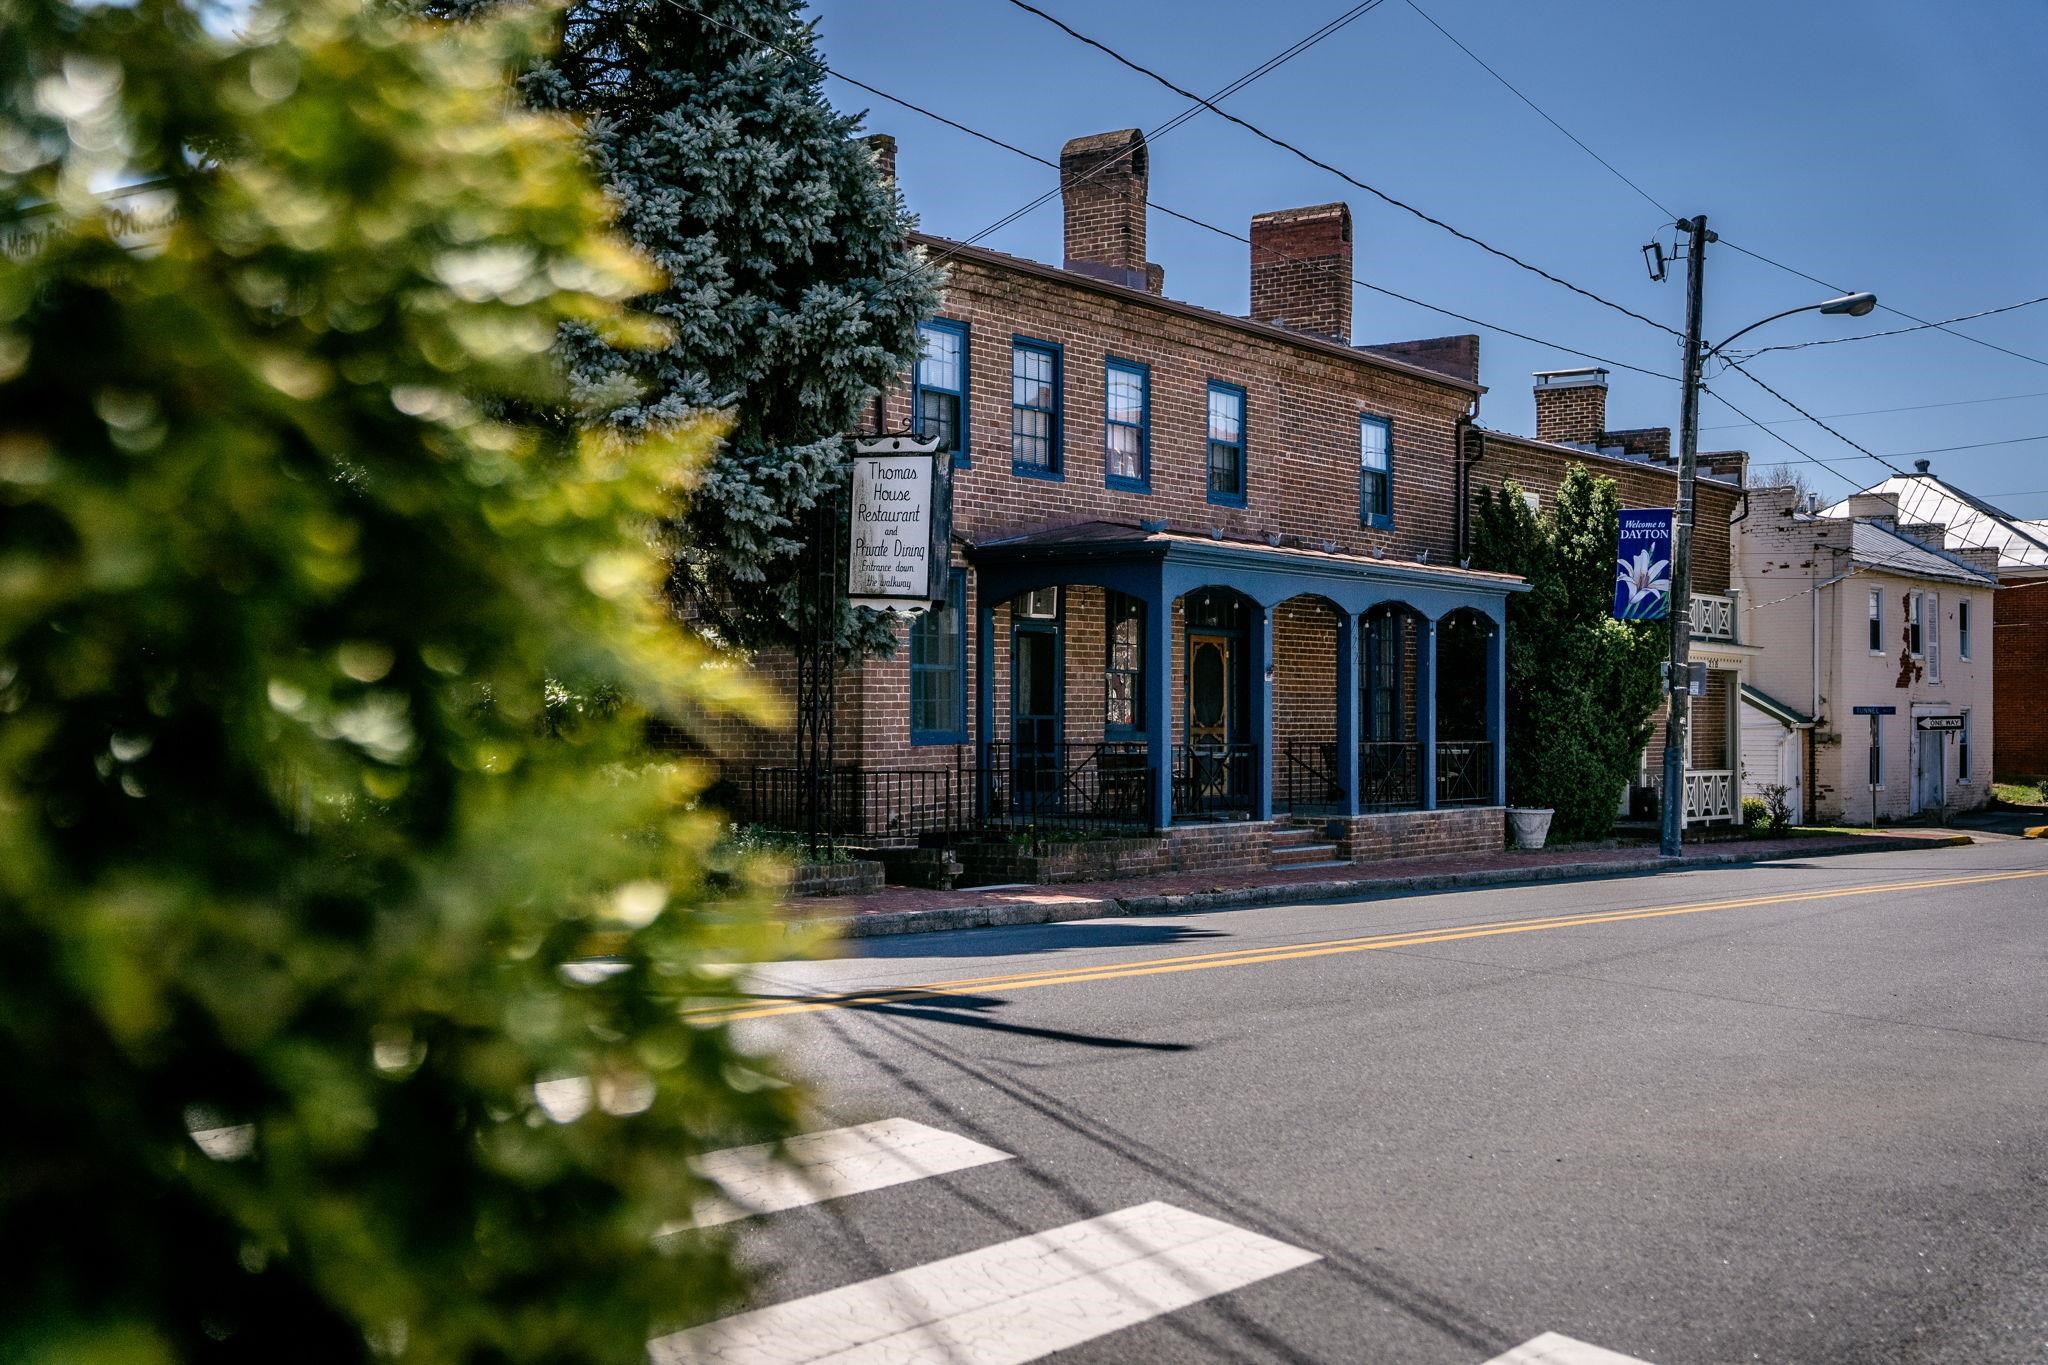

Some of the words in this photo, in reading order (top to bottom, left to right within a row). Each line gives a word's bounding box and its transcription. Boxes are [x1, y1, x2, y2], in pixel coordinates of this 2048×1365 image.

[868, 462, 918, 480] Thomas
[873, 483, 911, 501] House
[858, 503, 920, 522] Restaurant
[884, 526, 898, 536] and
[1625, 520, 1657, 528] Welcome
[1658, 520, 1666, 528] to
[1620, 529, 1669, 539] DAYTON
[855, 538, 889, 557] Private
[894, 538, 925, 561] Dining
[861, 560, 892, 572] Entrance
[895, 561, 914, 573] down
[866, 574, 877, 587] the
[880, 575, 911, 590] walkway
[1930, 719, 1944, 727] ONE
[1945, 719, 1959, 727] WAY
